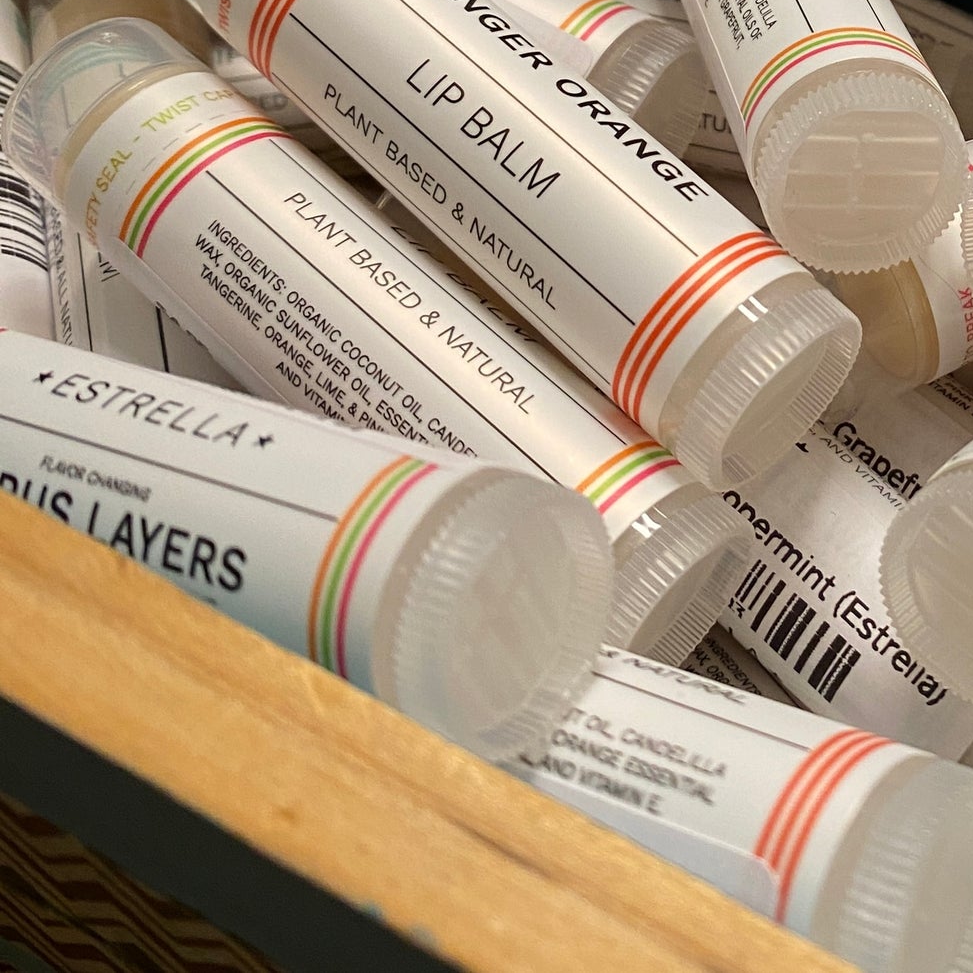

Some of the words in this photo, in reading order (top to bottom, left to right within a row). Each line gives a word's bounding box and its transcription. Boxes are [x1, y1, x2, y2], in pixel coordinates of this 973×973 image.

[742, 8, 757, 31] OILS
[750, 27, 763, 42] OF
[96, 149, 132, 193] SEAL
[142, 95, 201, 133] TWIST
[406, 59, 465, 107] LIP
[460, 106, 561, 199] BALM
[556, 78, 709, 202] ORANGE
[323, 84, 384, 144] PLANT
[385, 139, 447, 205] BASED
[451, 203, 464, 225] &
[470, 217, 557, 310] NATURAL
[195, 233, 221, 268] WAX,
[224, 262, 277, 313] ORGANIC
[276, 309, 351, 381] SUNFLOWER
[351, 377, 373, 406] OIL,
[200, 264, 262, 331] TANGERINE,
[264, 325, 314, 379] ORANGE,
[315, 372, 346, 408] LIME,
[208, 219, 287, 295] INGREDIENTS:
[286, 291, 342, 343] ORGANIC
[340, 339, 404, 398] COCONUT
[401, 394, 424, 423] OIL,
[284, 192, 357, 249] PLANT
[349, 248, 421, 309] BASED
[419, 310, 440, 329] &
[438, 325, 535, 415] NATURAL
[51, 373, 249, 447] ESTRELLA
[276, 361, 301, 387] AND
[820, 436, 853, 464] AND
[833, 590, 949, 706] (Estrella)
